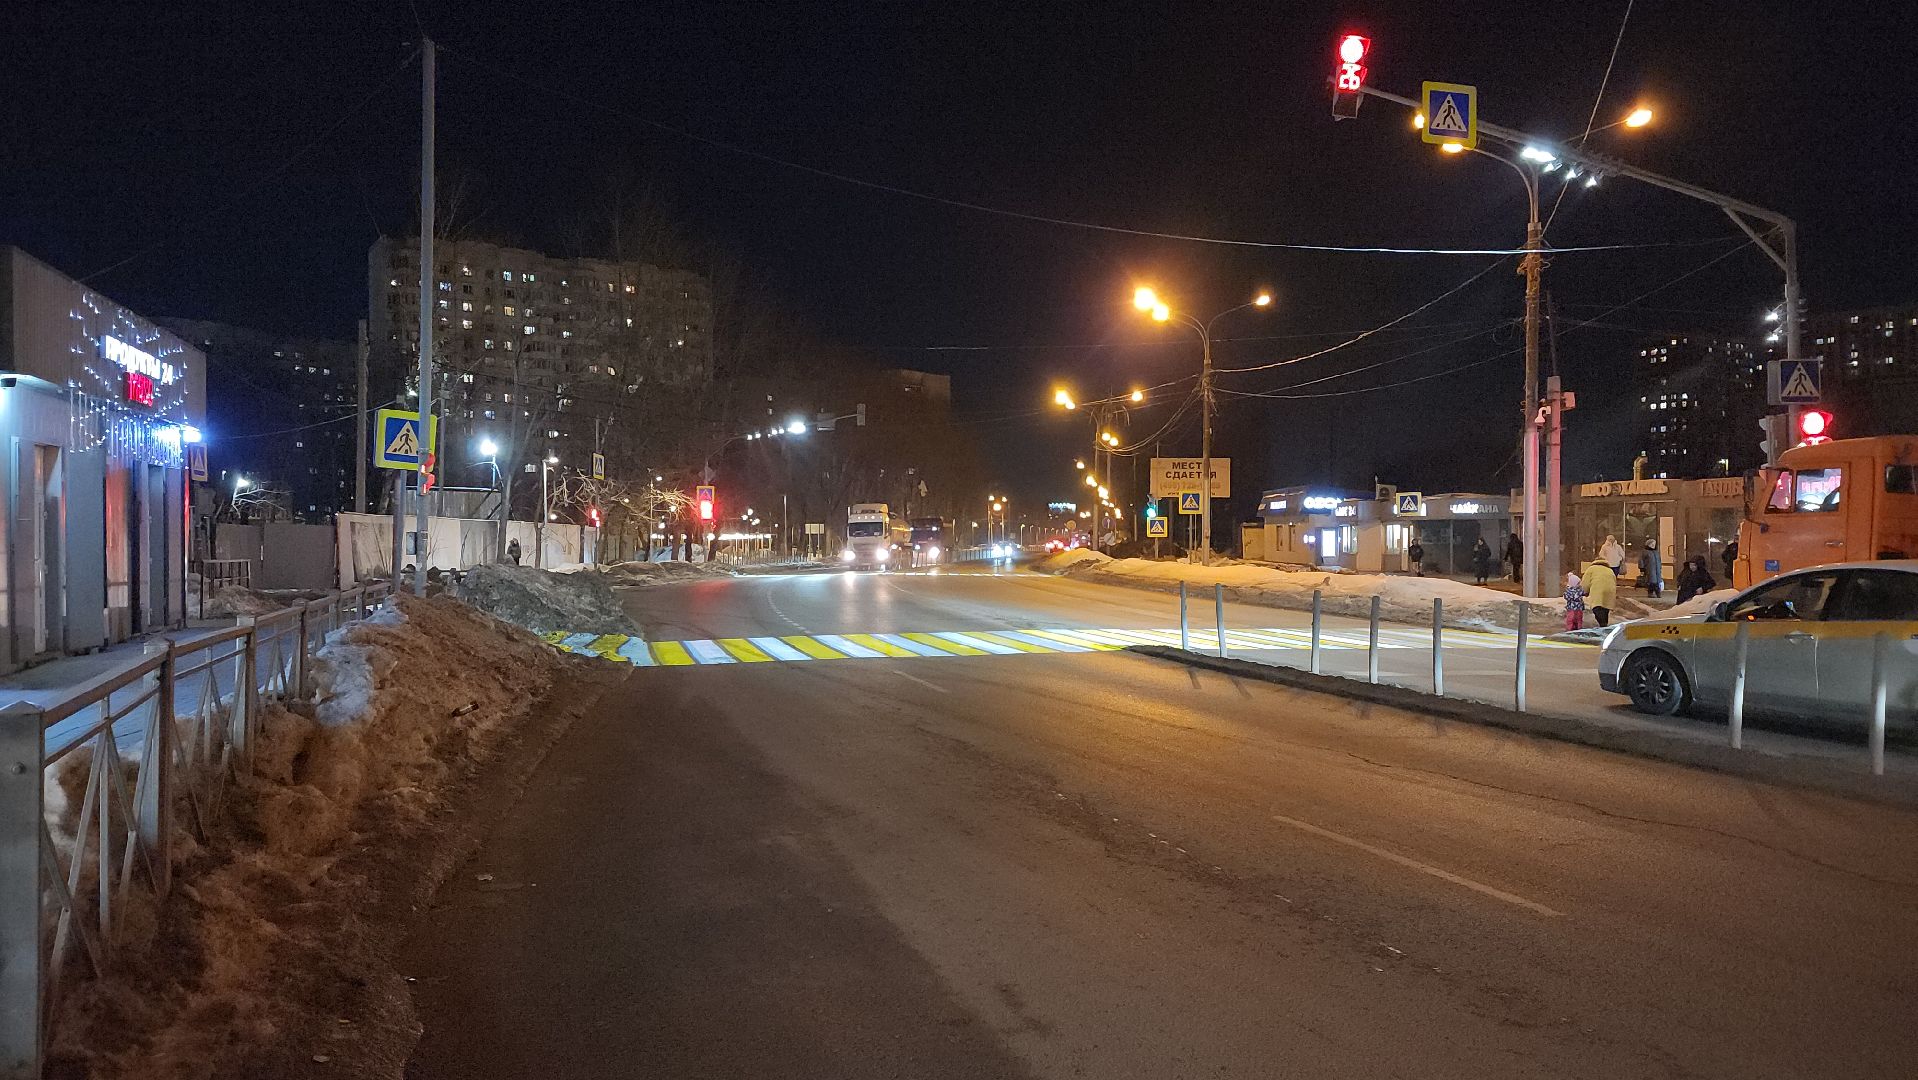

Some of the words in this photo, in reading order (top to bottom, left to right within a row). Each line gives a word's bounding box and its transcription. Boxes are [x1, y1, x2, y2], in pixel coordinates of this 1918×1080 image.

[106, 335, 161, 380] ПРОДУКТЫ
[161, 362, 174, 386] 24
[1172, 462, 1202, 470] МЕСТ
[1166, 471, 1217, 480] СДАЕТЯ
[1699, 479, 1743, 497] ТАНДЫ
